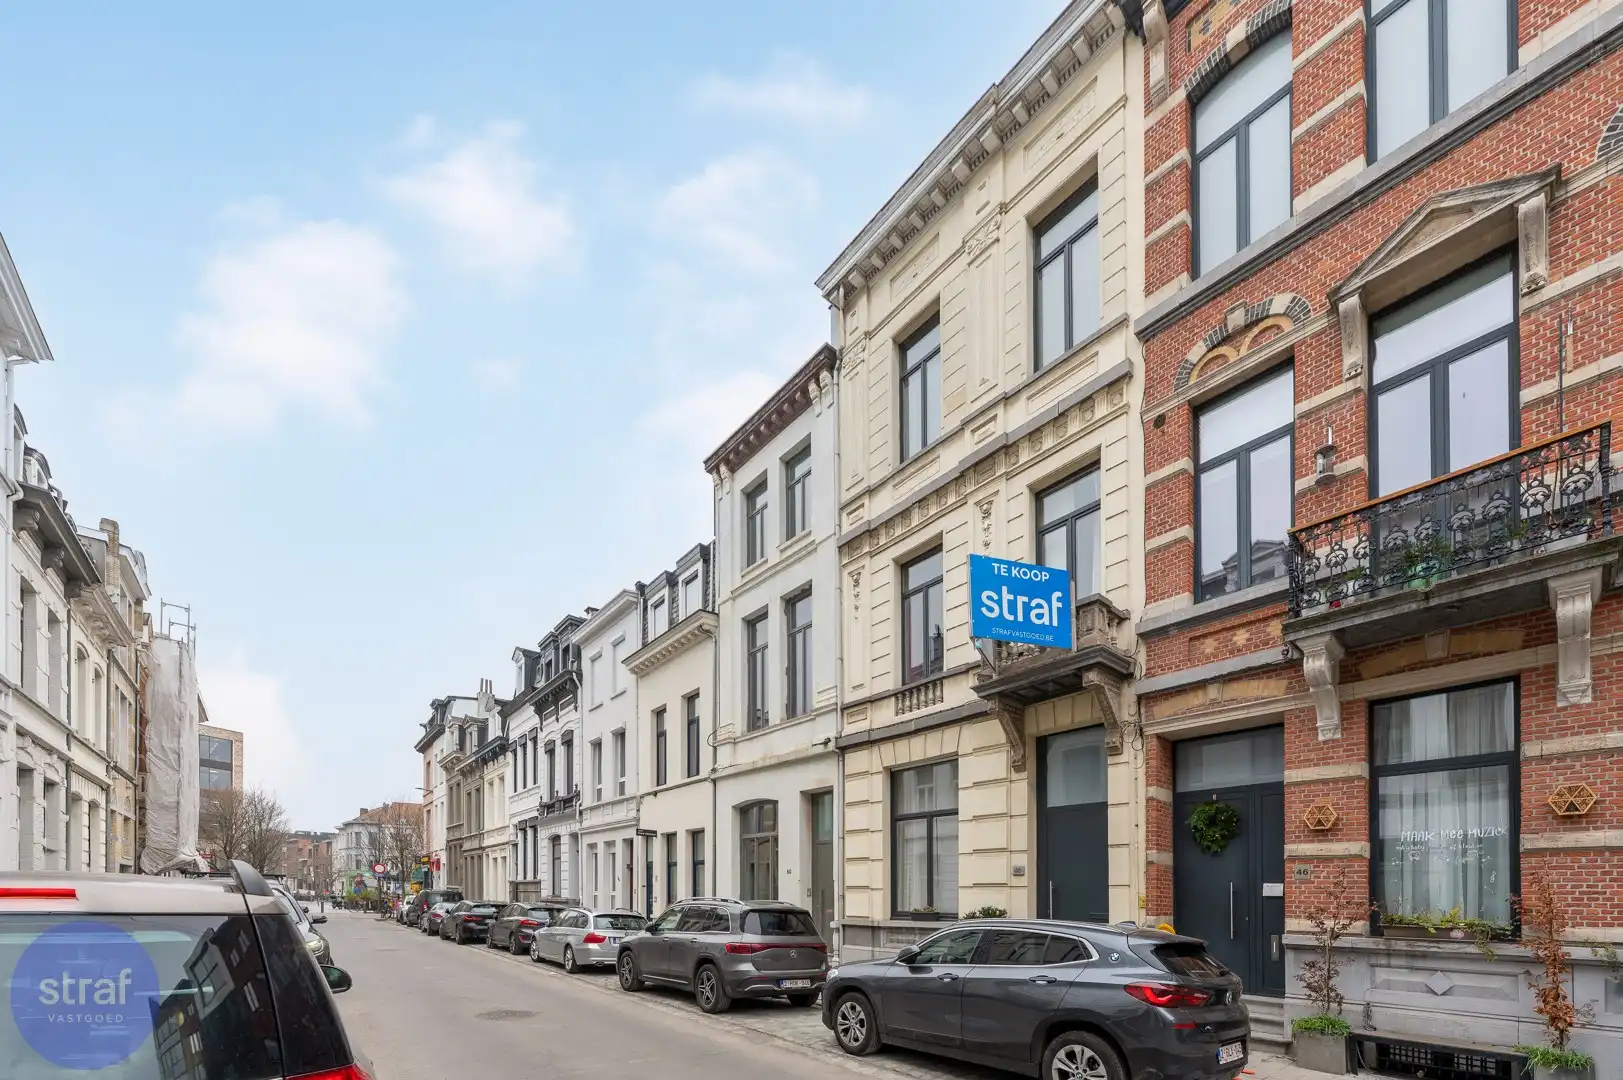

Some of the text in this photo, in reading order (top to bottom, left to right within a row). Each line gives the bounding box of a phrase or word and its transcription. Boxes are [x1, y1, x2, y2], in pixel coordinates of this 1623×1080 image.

[992, 563, 1050, 582] TE KOOP
[980, 585, 1063, 627] straf
